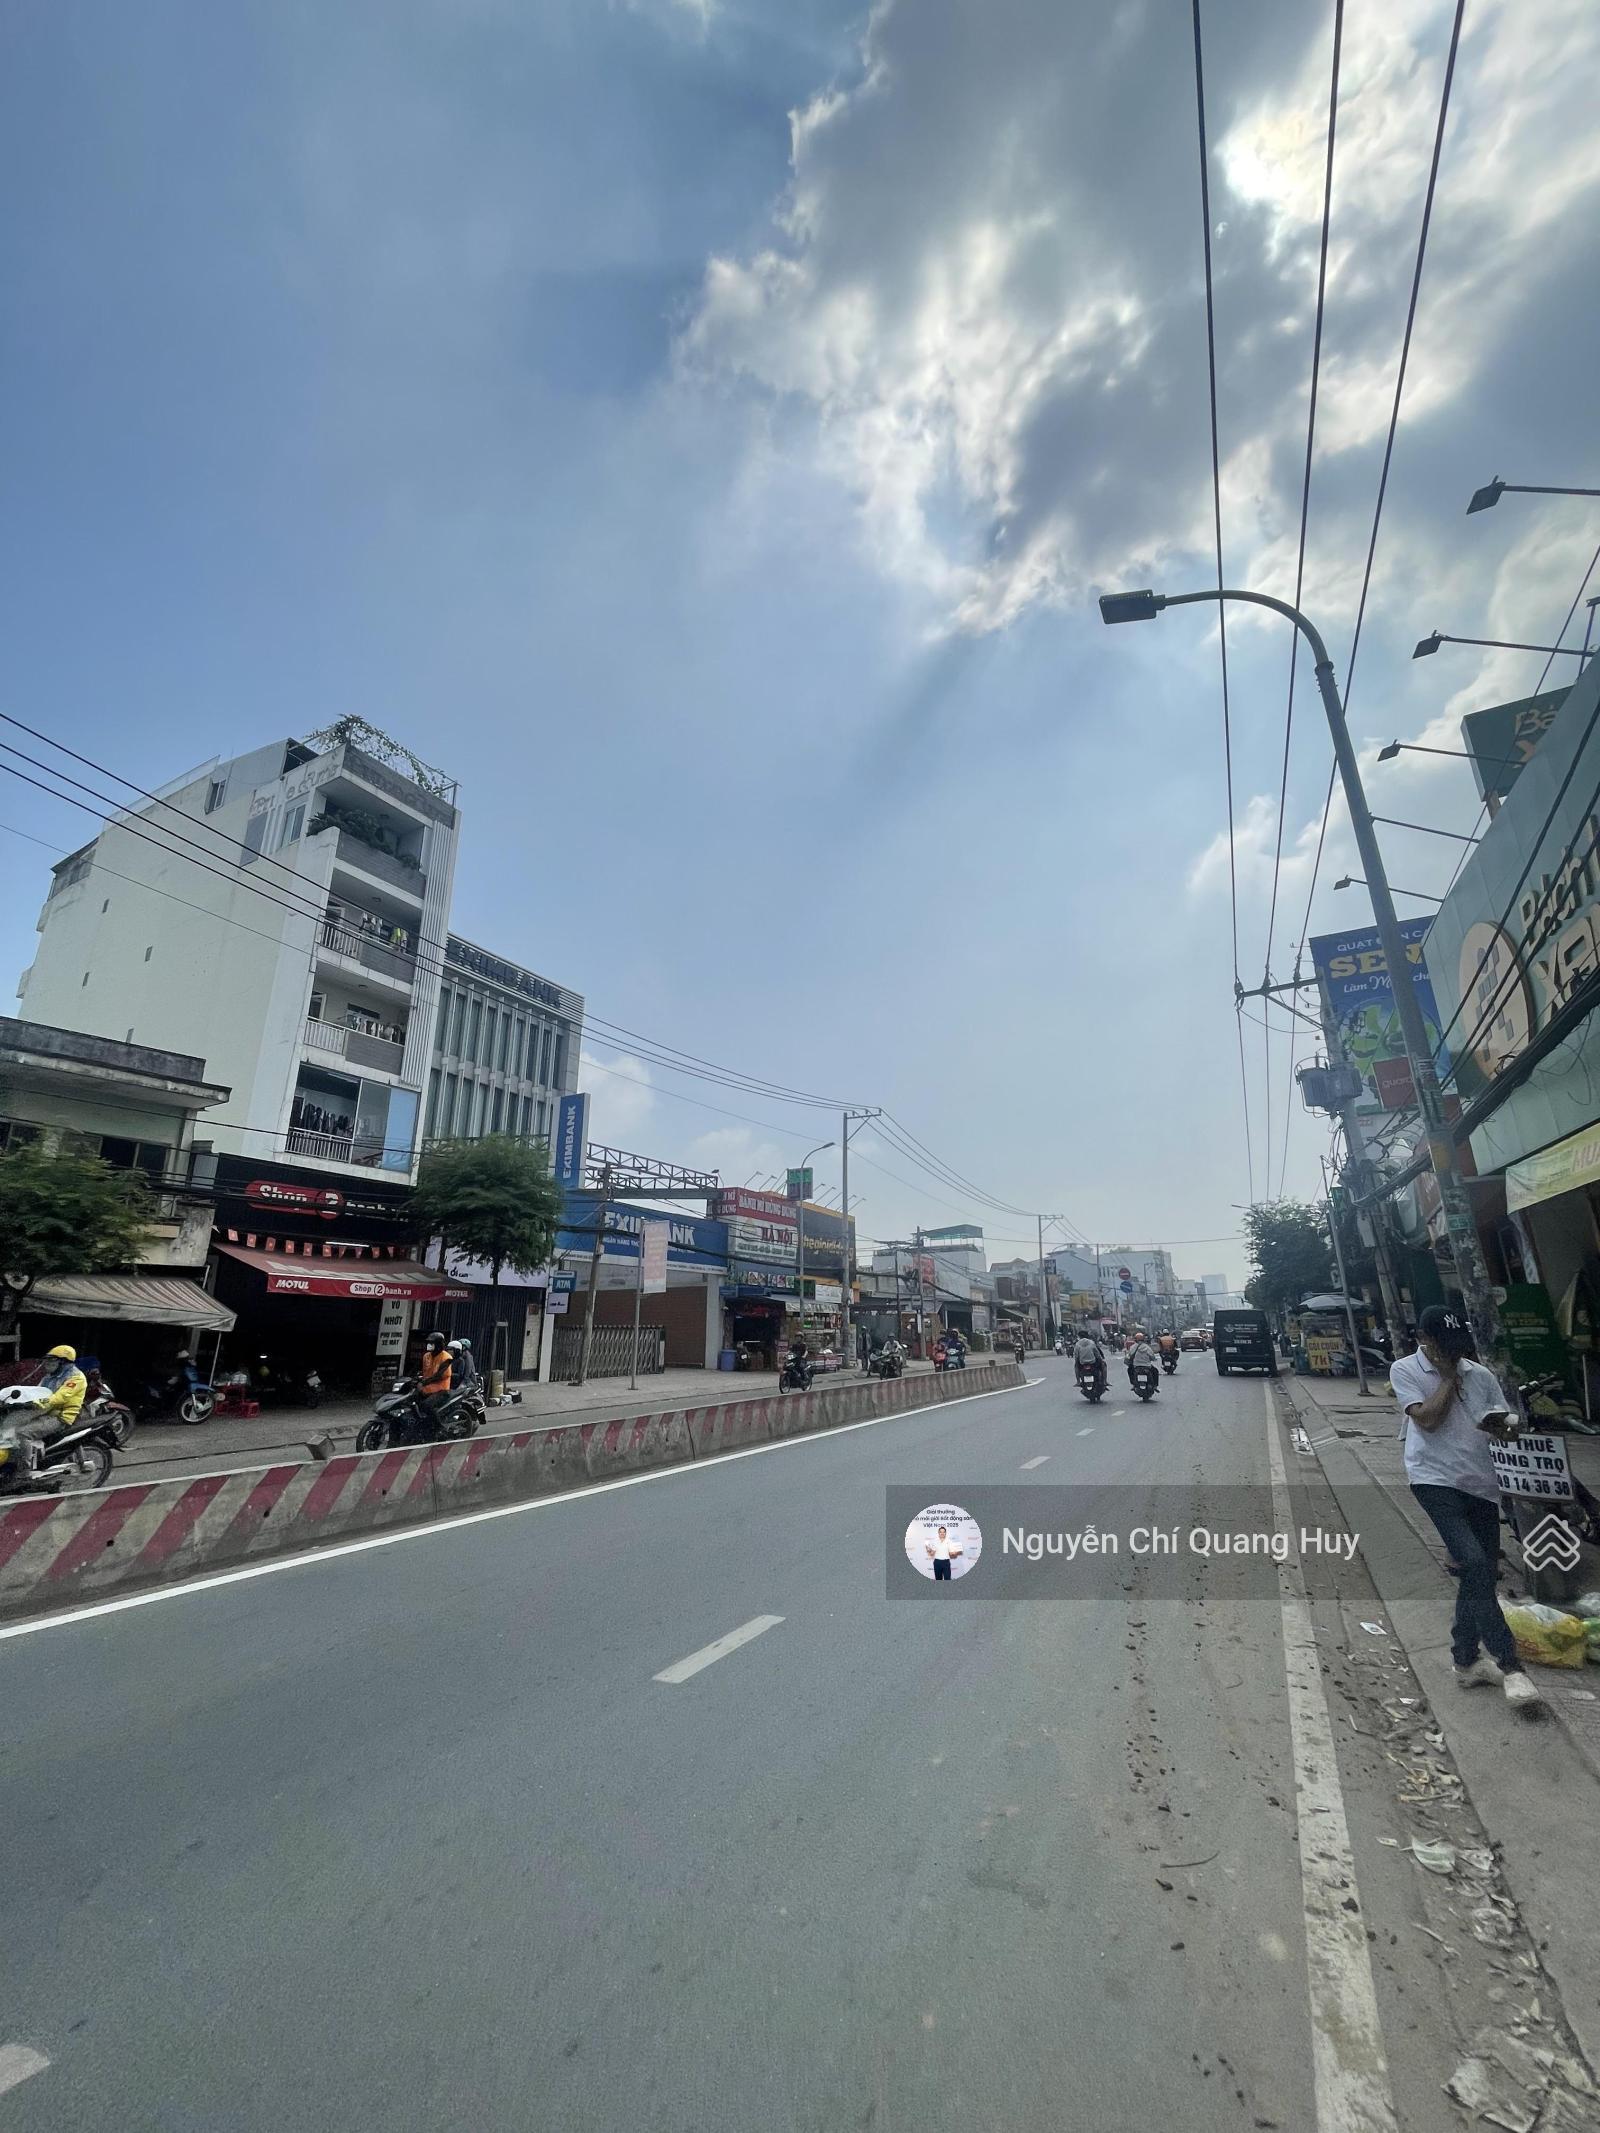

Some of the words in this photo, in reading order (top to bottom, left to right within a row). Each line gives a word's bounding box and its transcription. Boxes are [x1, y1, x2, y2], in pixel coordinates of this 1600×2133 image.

[562, 1104, 577, 1179] EXIMBANK
[275, 1279, 310, 1290] MOTUL
[555, 1279, 571, 1289] ATM
[1516, 1437, 1557, 1453] THUÊ
[1489, 1448, 1530, 1468] HÒNG
[1533, 1455, 1565, 1474] TRỌ
[1513, 1477, 1531, 1493] 14
